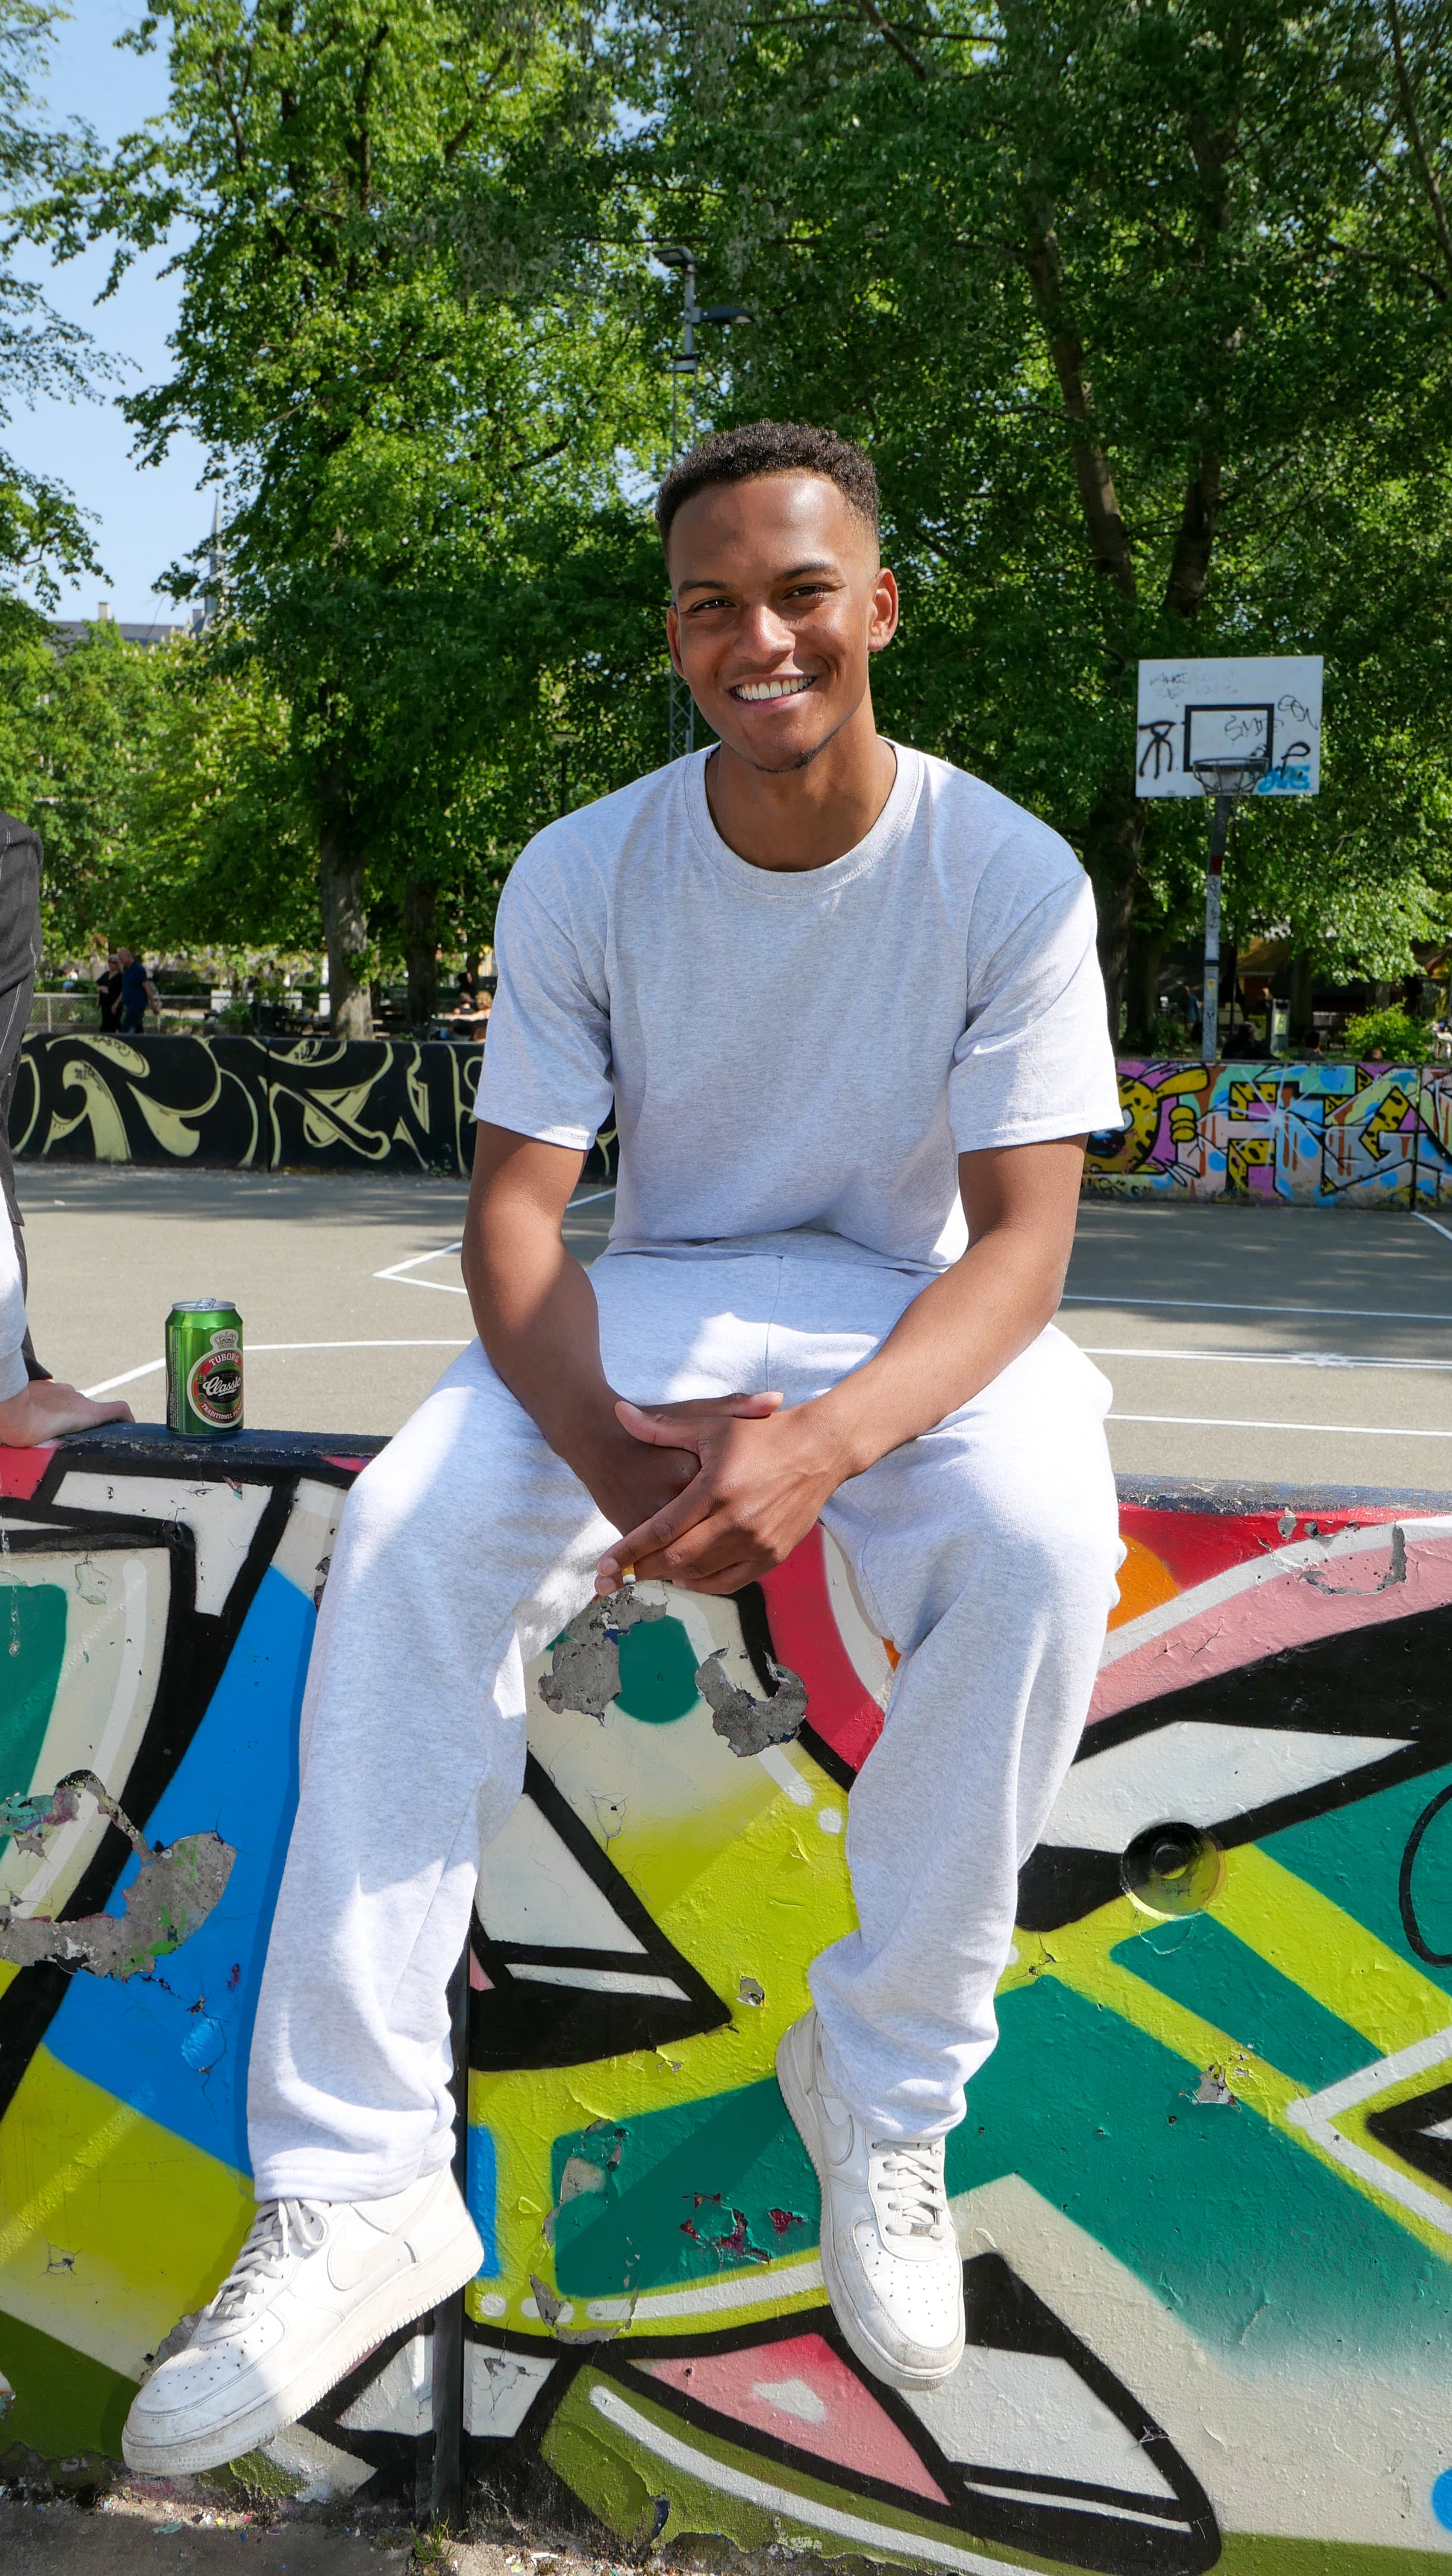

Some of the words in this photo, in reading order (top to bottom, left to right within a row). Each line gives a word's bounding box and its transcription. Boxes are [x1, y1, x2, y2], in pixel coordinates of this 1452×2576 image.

[209, 1353, 240, 1366] TUBORG
[202, 1376, 241, 1396] Classic
[201, 1403, 233, 1419] TRADITIONEL
